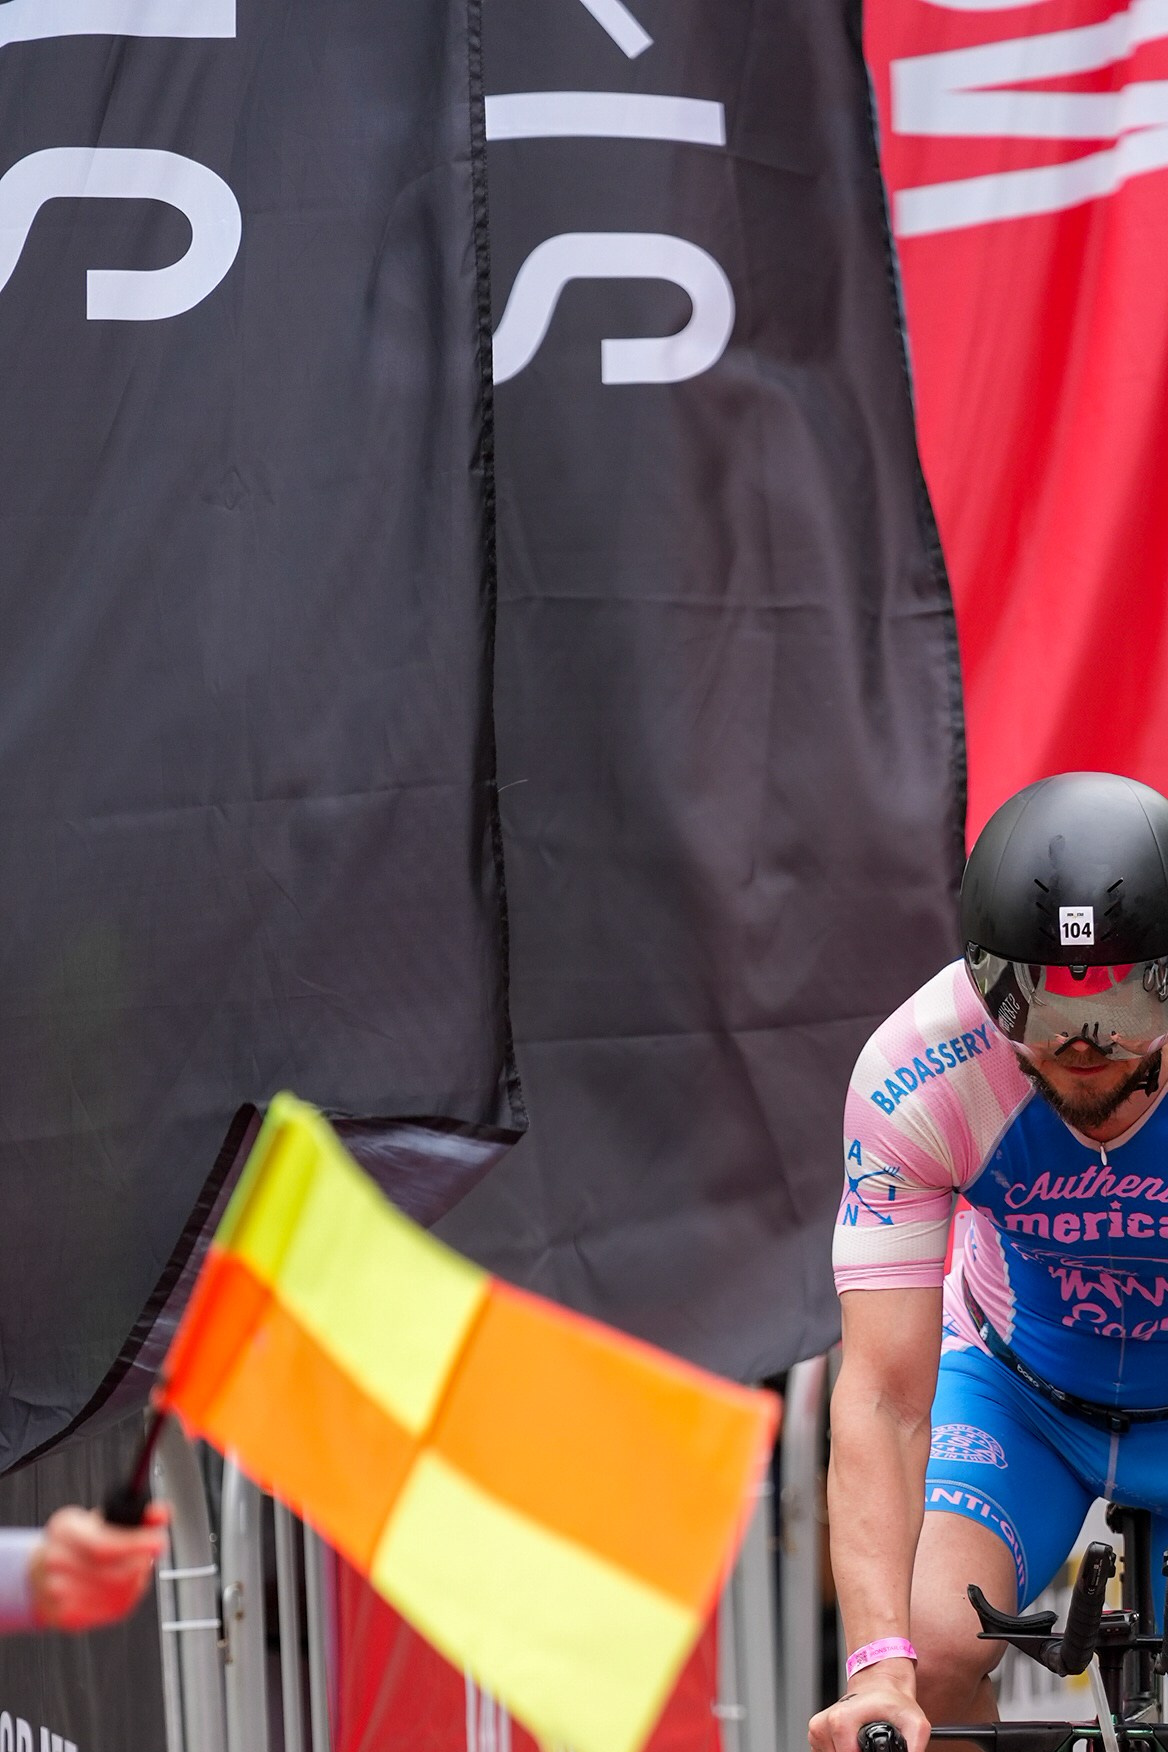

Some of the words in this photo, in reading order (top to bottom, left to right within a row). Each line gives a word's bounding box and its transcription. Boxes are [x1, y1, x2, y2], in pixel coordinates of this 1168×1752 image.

[1062, 922, 1092, 939] 104
[870, 1023, 992, 1116] BADASSERY
[925, 1487, 1026, 1587] NTI-QUIT
